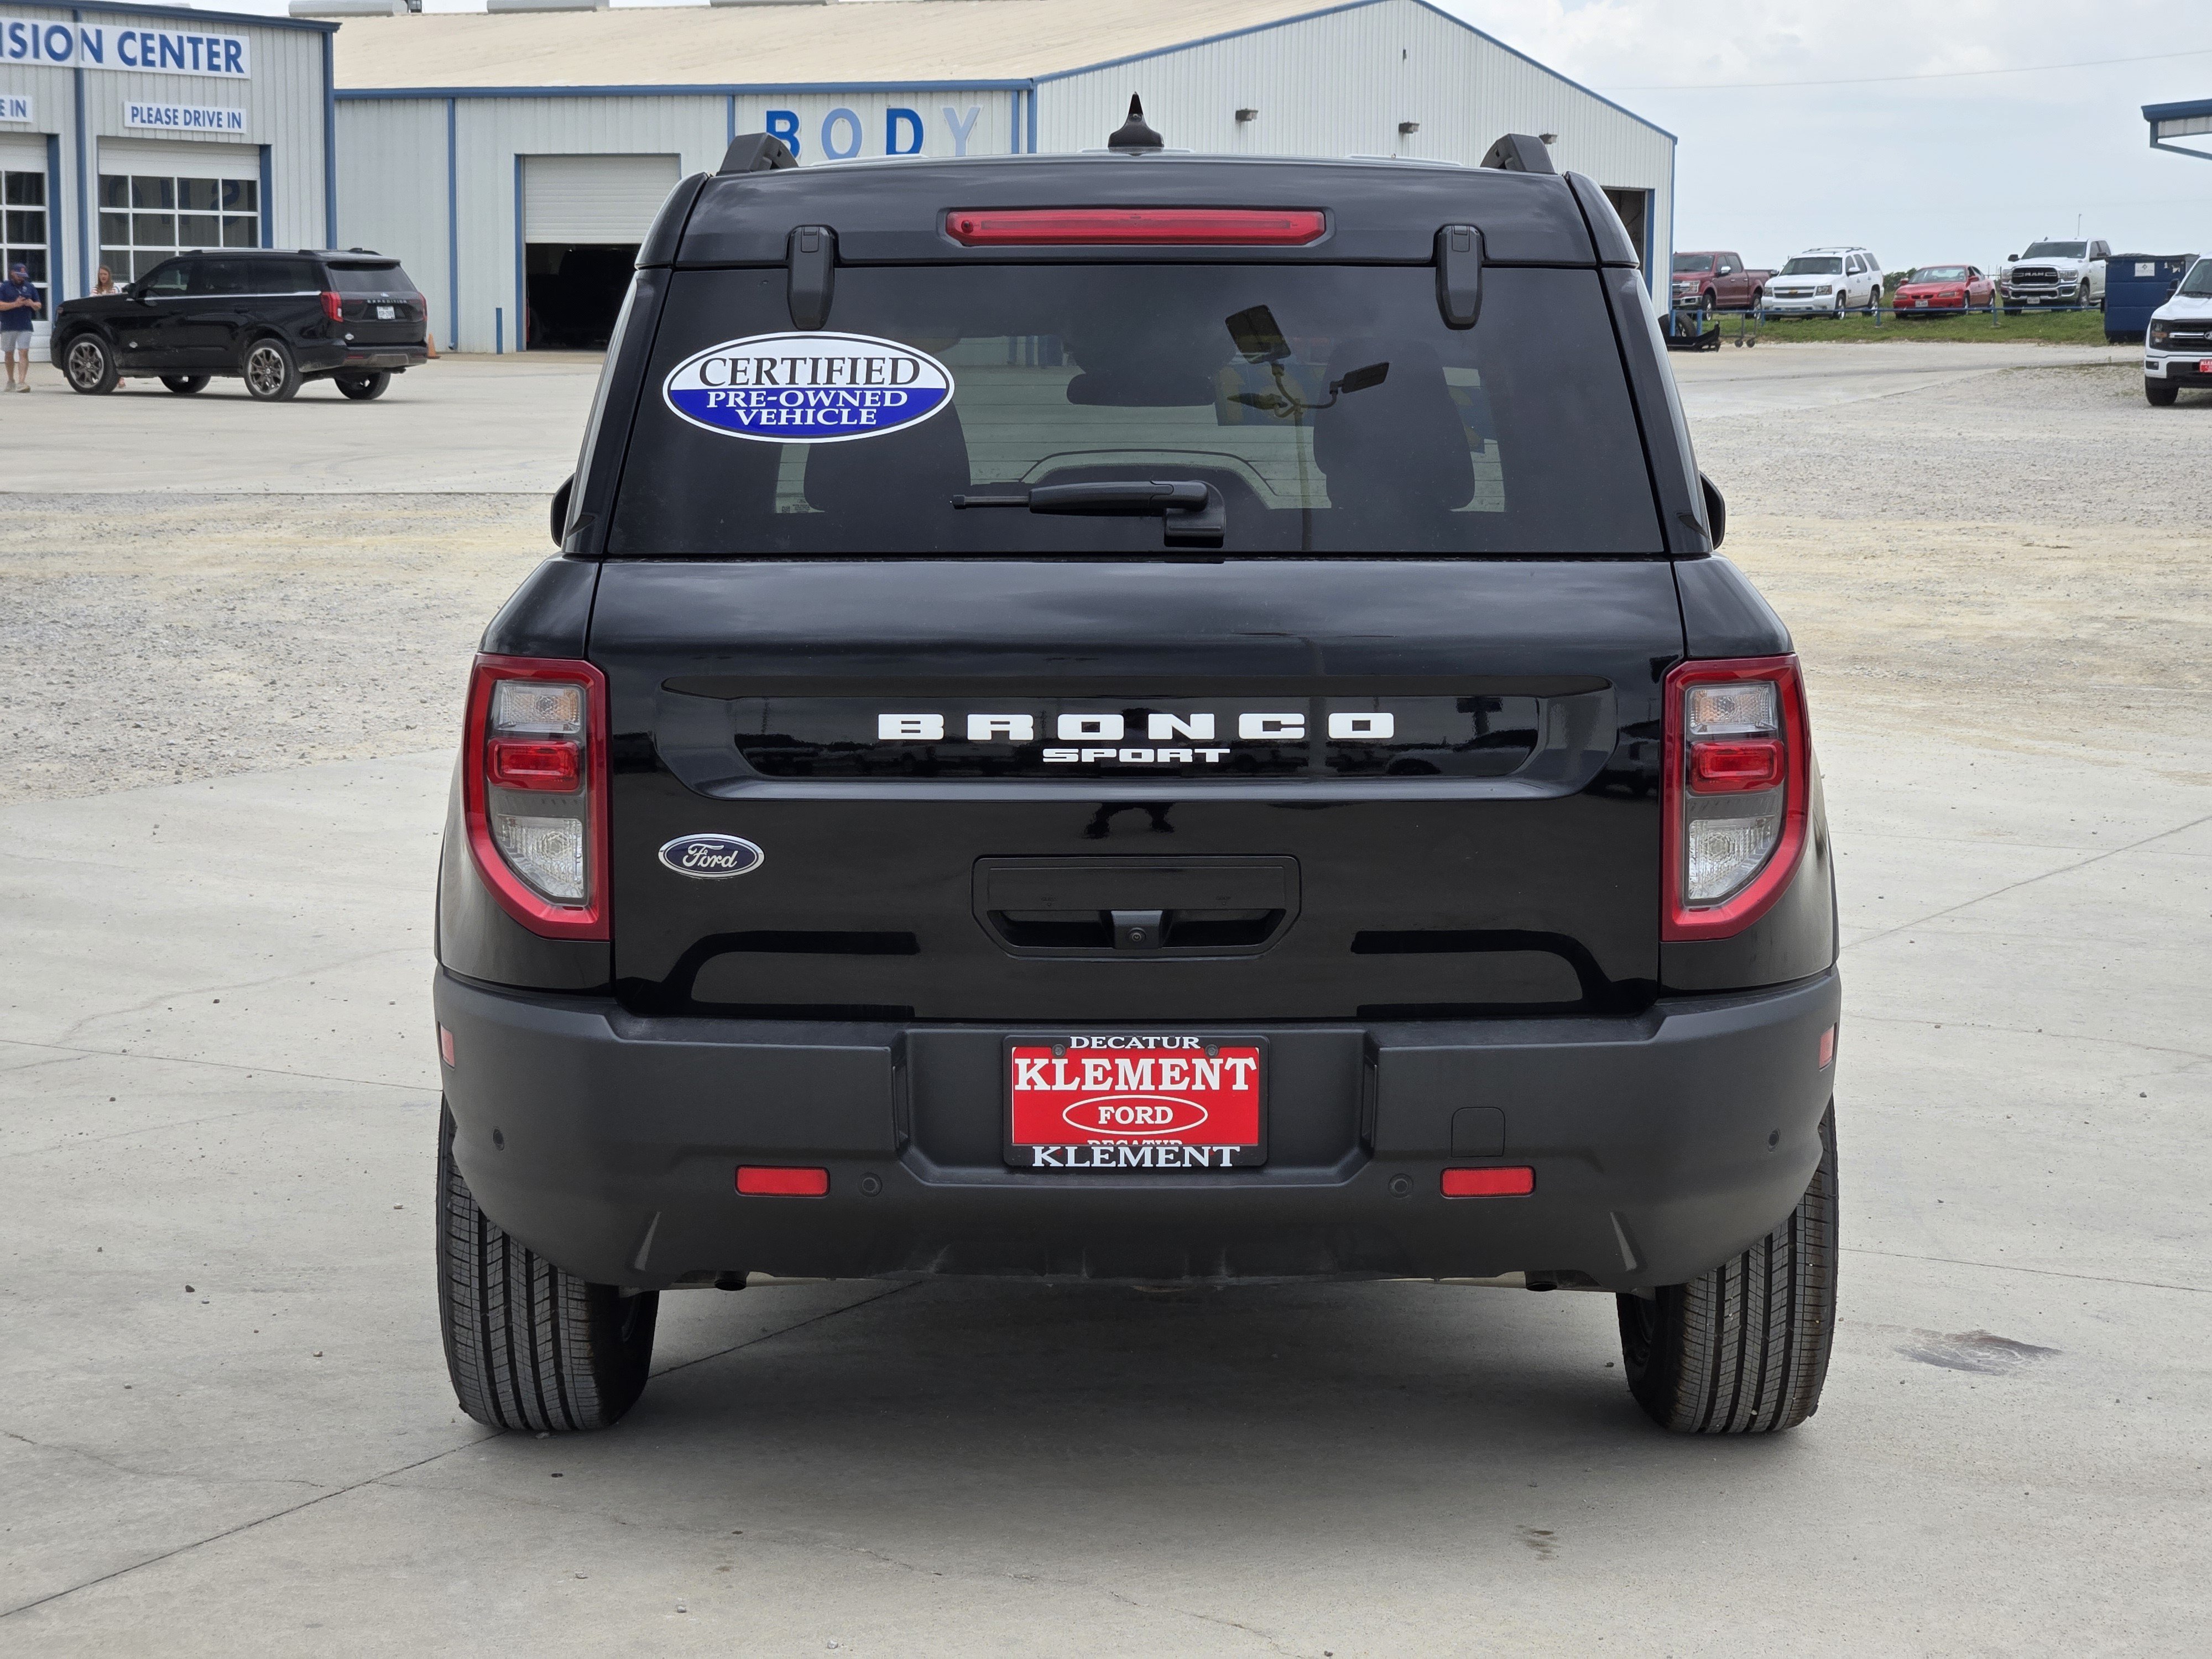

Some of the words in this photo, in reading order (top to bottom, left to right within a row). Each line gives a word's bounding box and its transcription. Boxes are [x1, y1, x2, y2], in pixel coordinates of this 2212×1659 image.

[117, 31, 244, 73] CENTER
[10, 99, 27, 117] IN
[131, 106, 179, 126] PLEASE
[184, 109, 223, 128] DRIVE
[227, 112, 242, 129] IN
[766, 107, 981, 159] BODY
[699, 357, 920, 387] CERTIFIED
[707, 390, 907, 408] PRE-OWNED
[735, 408, 877, 425] VEHICLE
[878, 712, 1394, 740] BRONCO
[1042, 748, 1230, 763] SPORT
[682, 843, 738, 867] Ford
[1070, 1036, 1201, 1049] DECATUR
[1014, 1057, 1257, 1091] KLEMENT
[1098, 1106, 1173, 1124] FORD
[1032, 1146, 1240, 1167] KLEMENT
